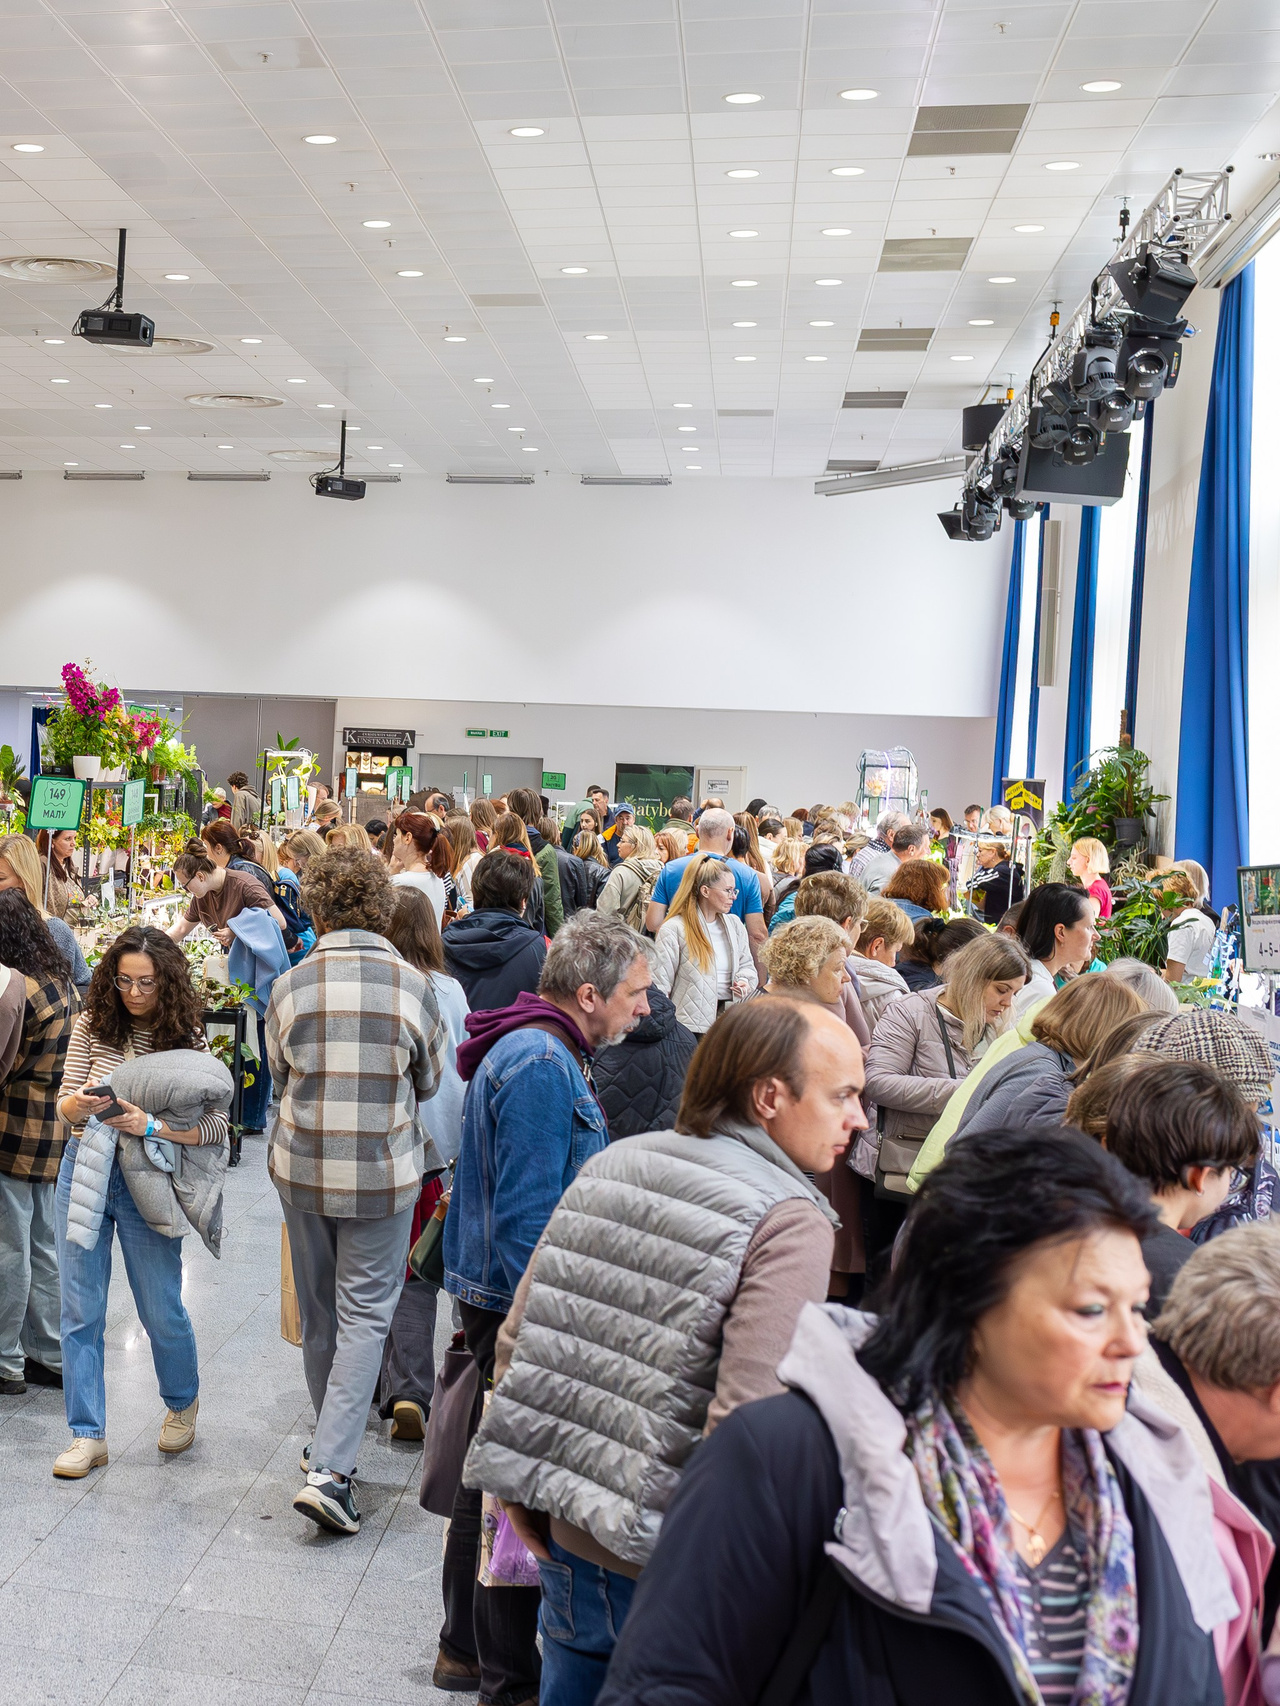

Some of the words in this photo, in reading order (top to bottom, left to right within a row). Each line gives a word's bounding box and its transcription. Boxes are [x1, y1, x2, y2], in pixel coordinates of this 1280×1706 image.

[344, 730, 413, 746] KUNSTKAMERA
[49, 788, 66, 800] 149
[42, 809, 67, 819] МАЛУ
[633, 802, 671, 819] atyb
